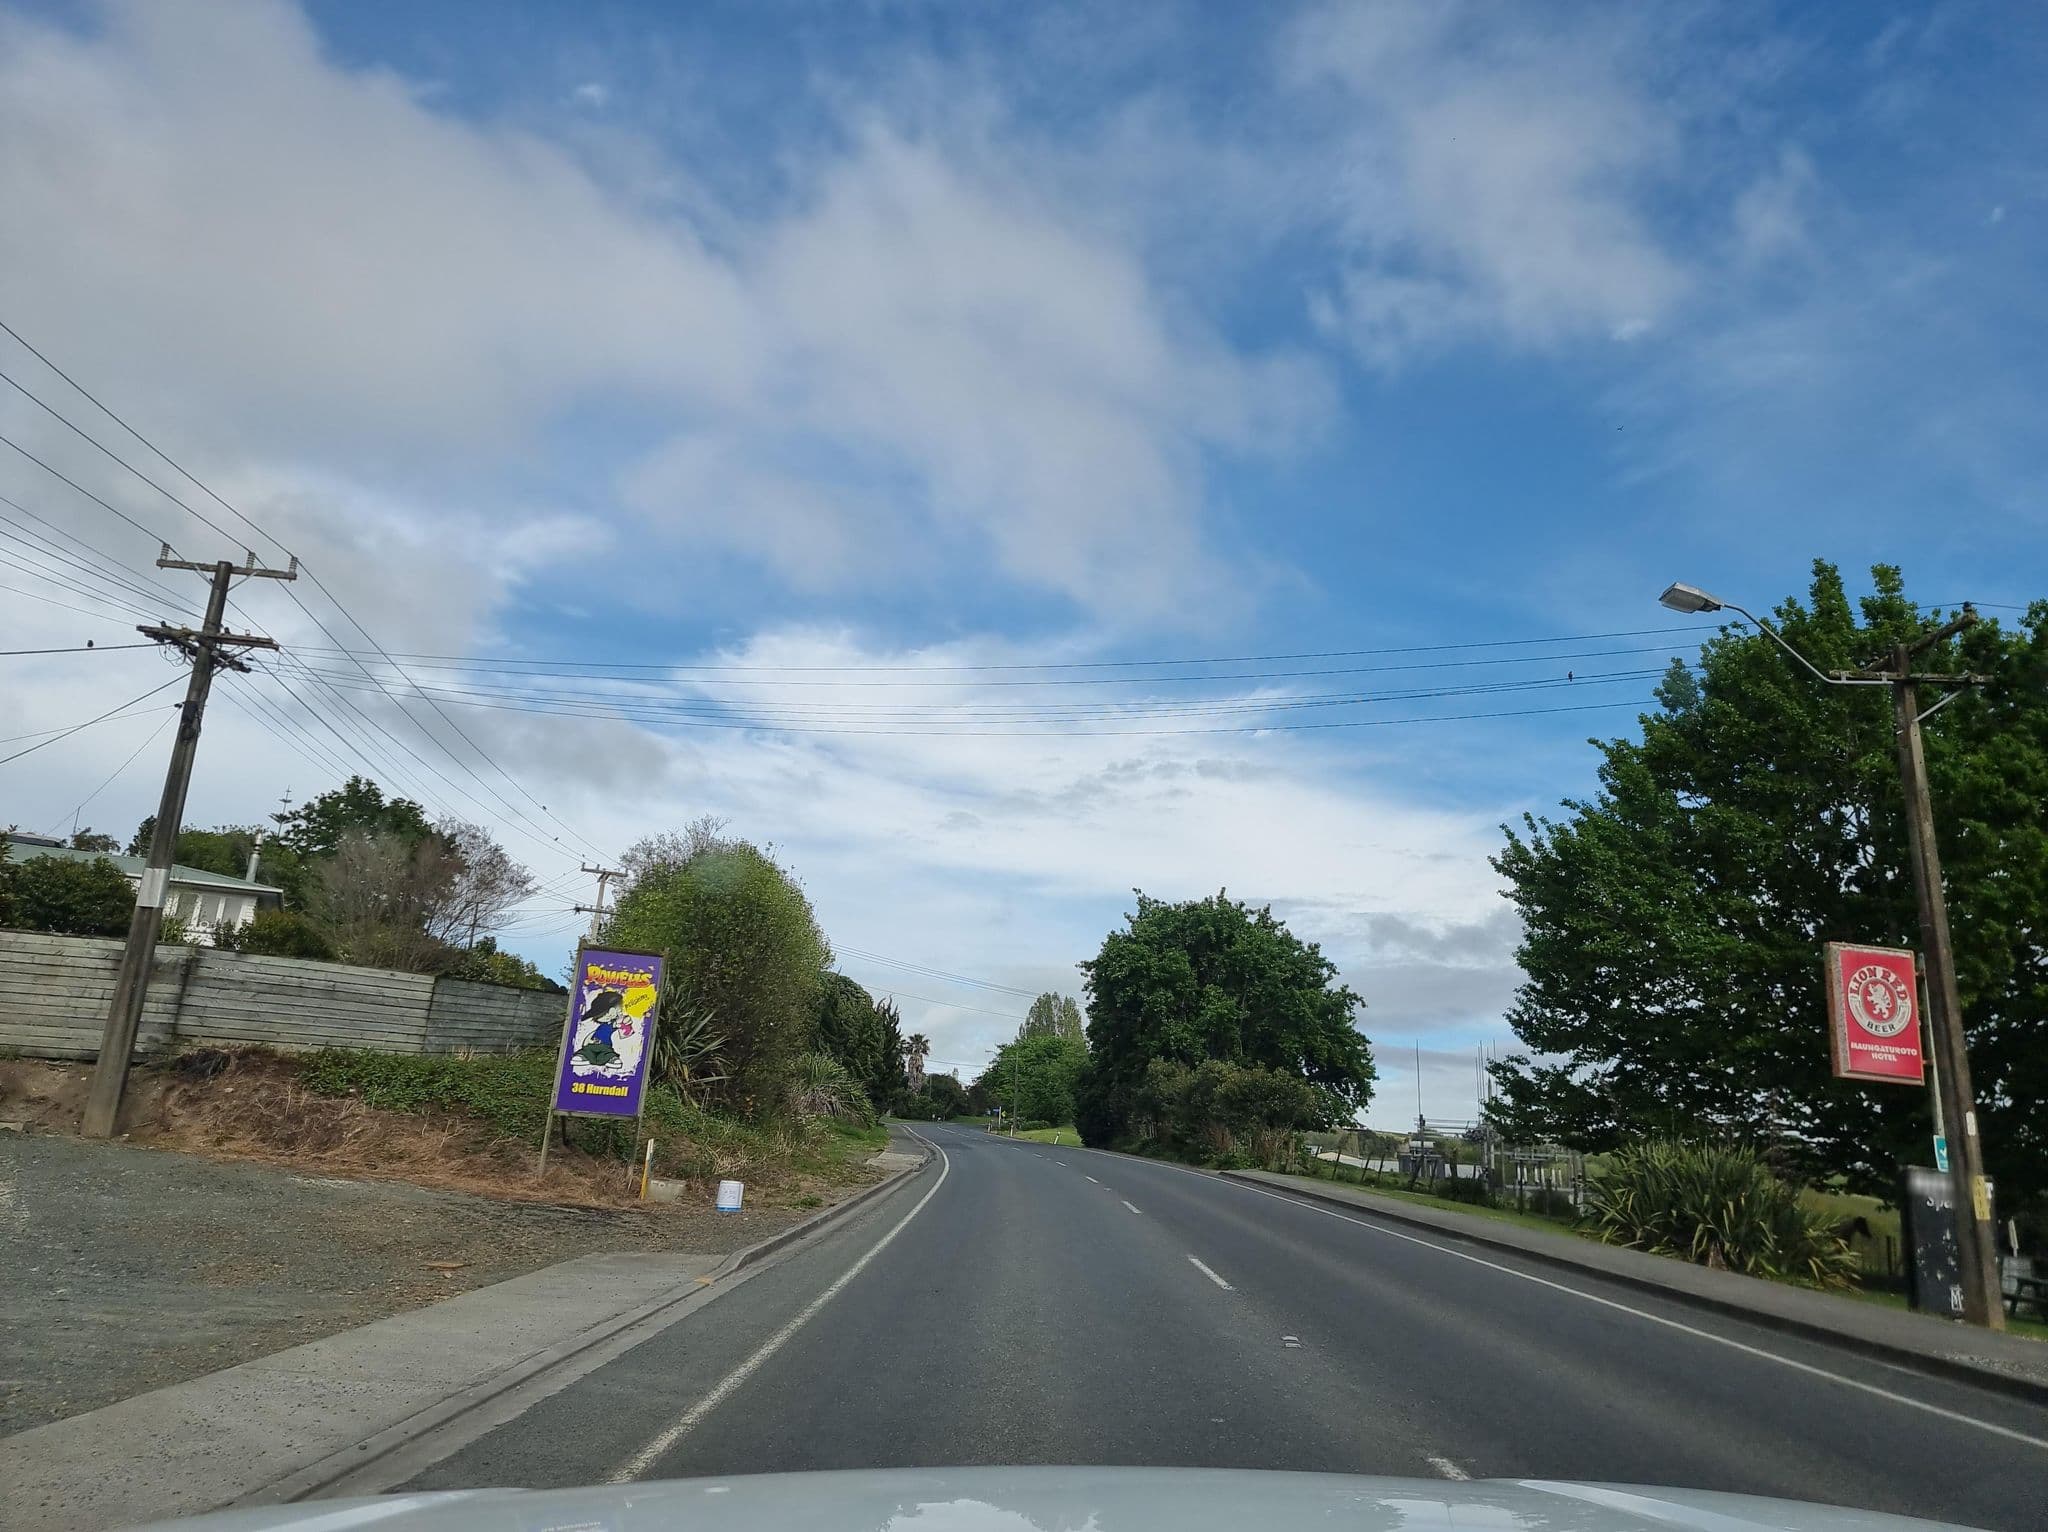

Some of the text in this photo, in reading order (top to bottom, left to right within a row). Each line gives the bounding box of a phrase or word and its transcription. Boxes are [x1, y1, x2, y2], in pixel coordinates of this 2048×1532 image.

[1849, 967, 1908, 1001] LION RED
[1867, 1021, 1896, 1033] BEER
[1850, 1042, 1918, 1056] MAUNGATUROTO
[1872, 1053, 1898, 1062] HOTEL
[571, 1082, 629, 1097] 38 Hurndall
